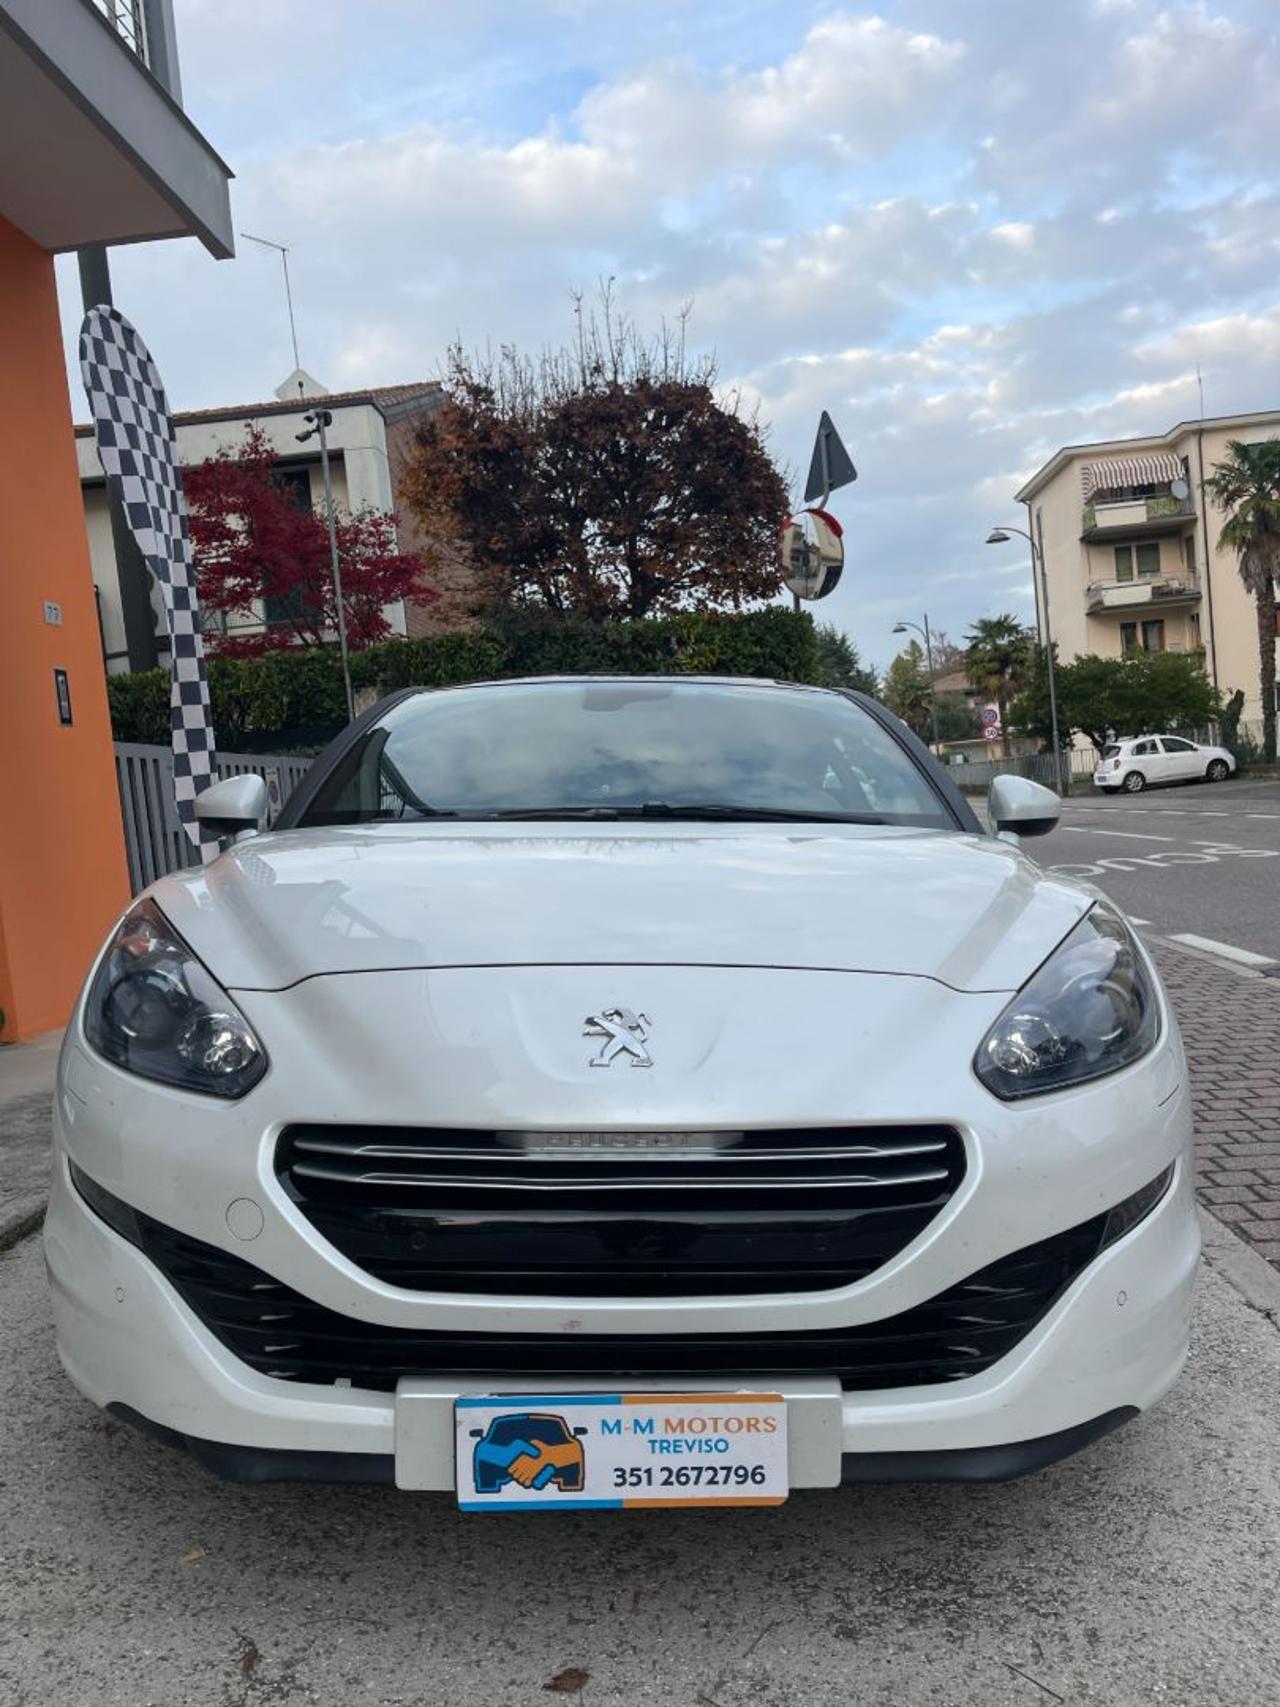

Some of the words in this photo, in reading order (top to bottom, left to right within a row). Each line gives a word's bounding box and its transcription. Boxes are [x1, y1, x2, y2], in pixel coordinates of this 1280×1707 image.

[601, 1418, 654, 1435] M-M
[664, 1416, 777, 1434] MOTORS
[648, 1438, 729, 1455] TREVISO
[613, 1467, 652, 1487] 351
[660, 1465, 766, 1486] 2672796
